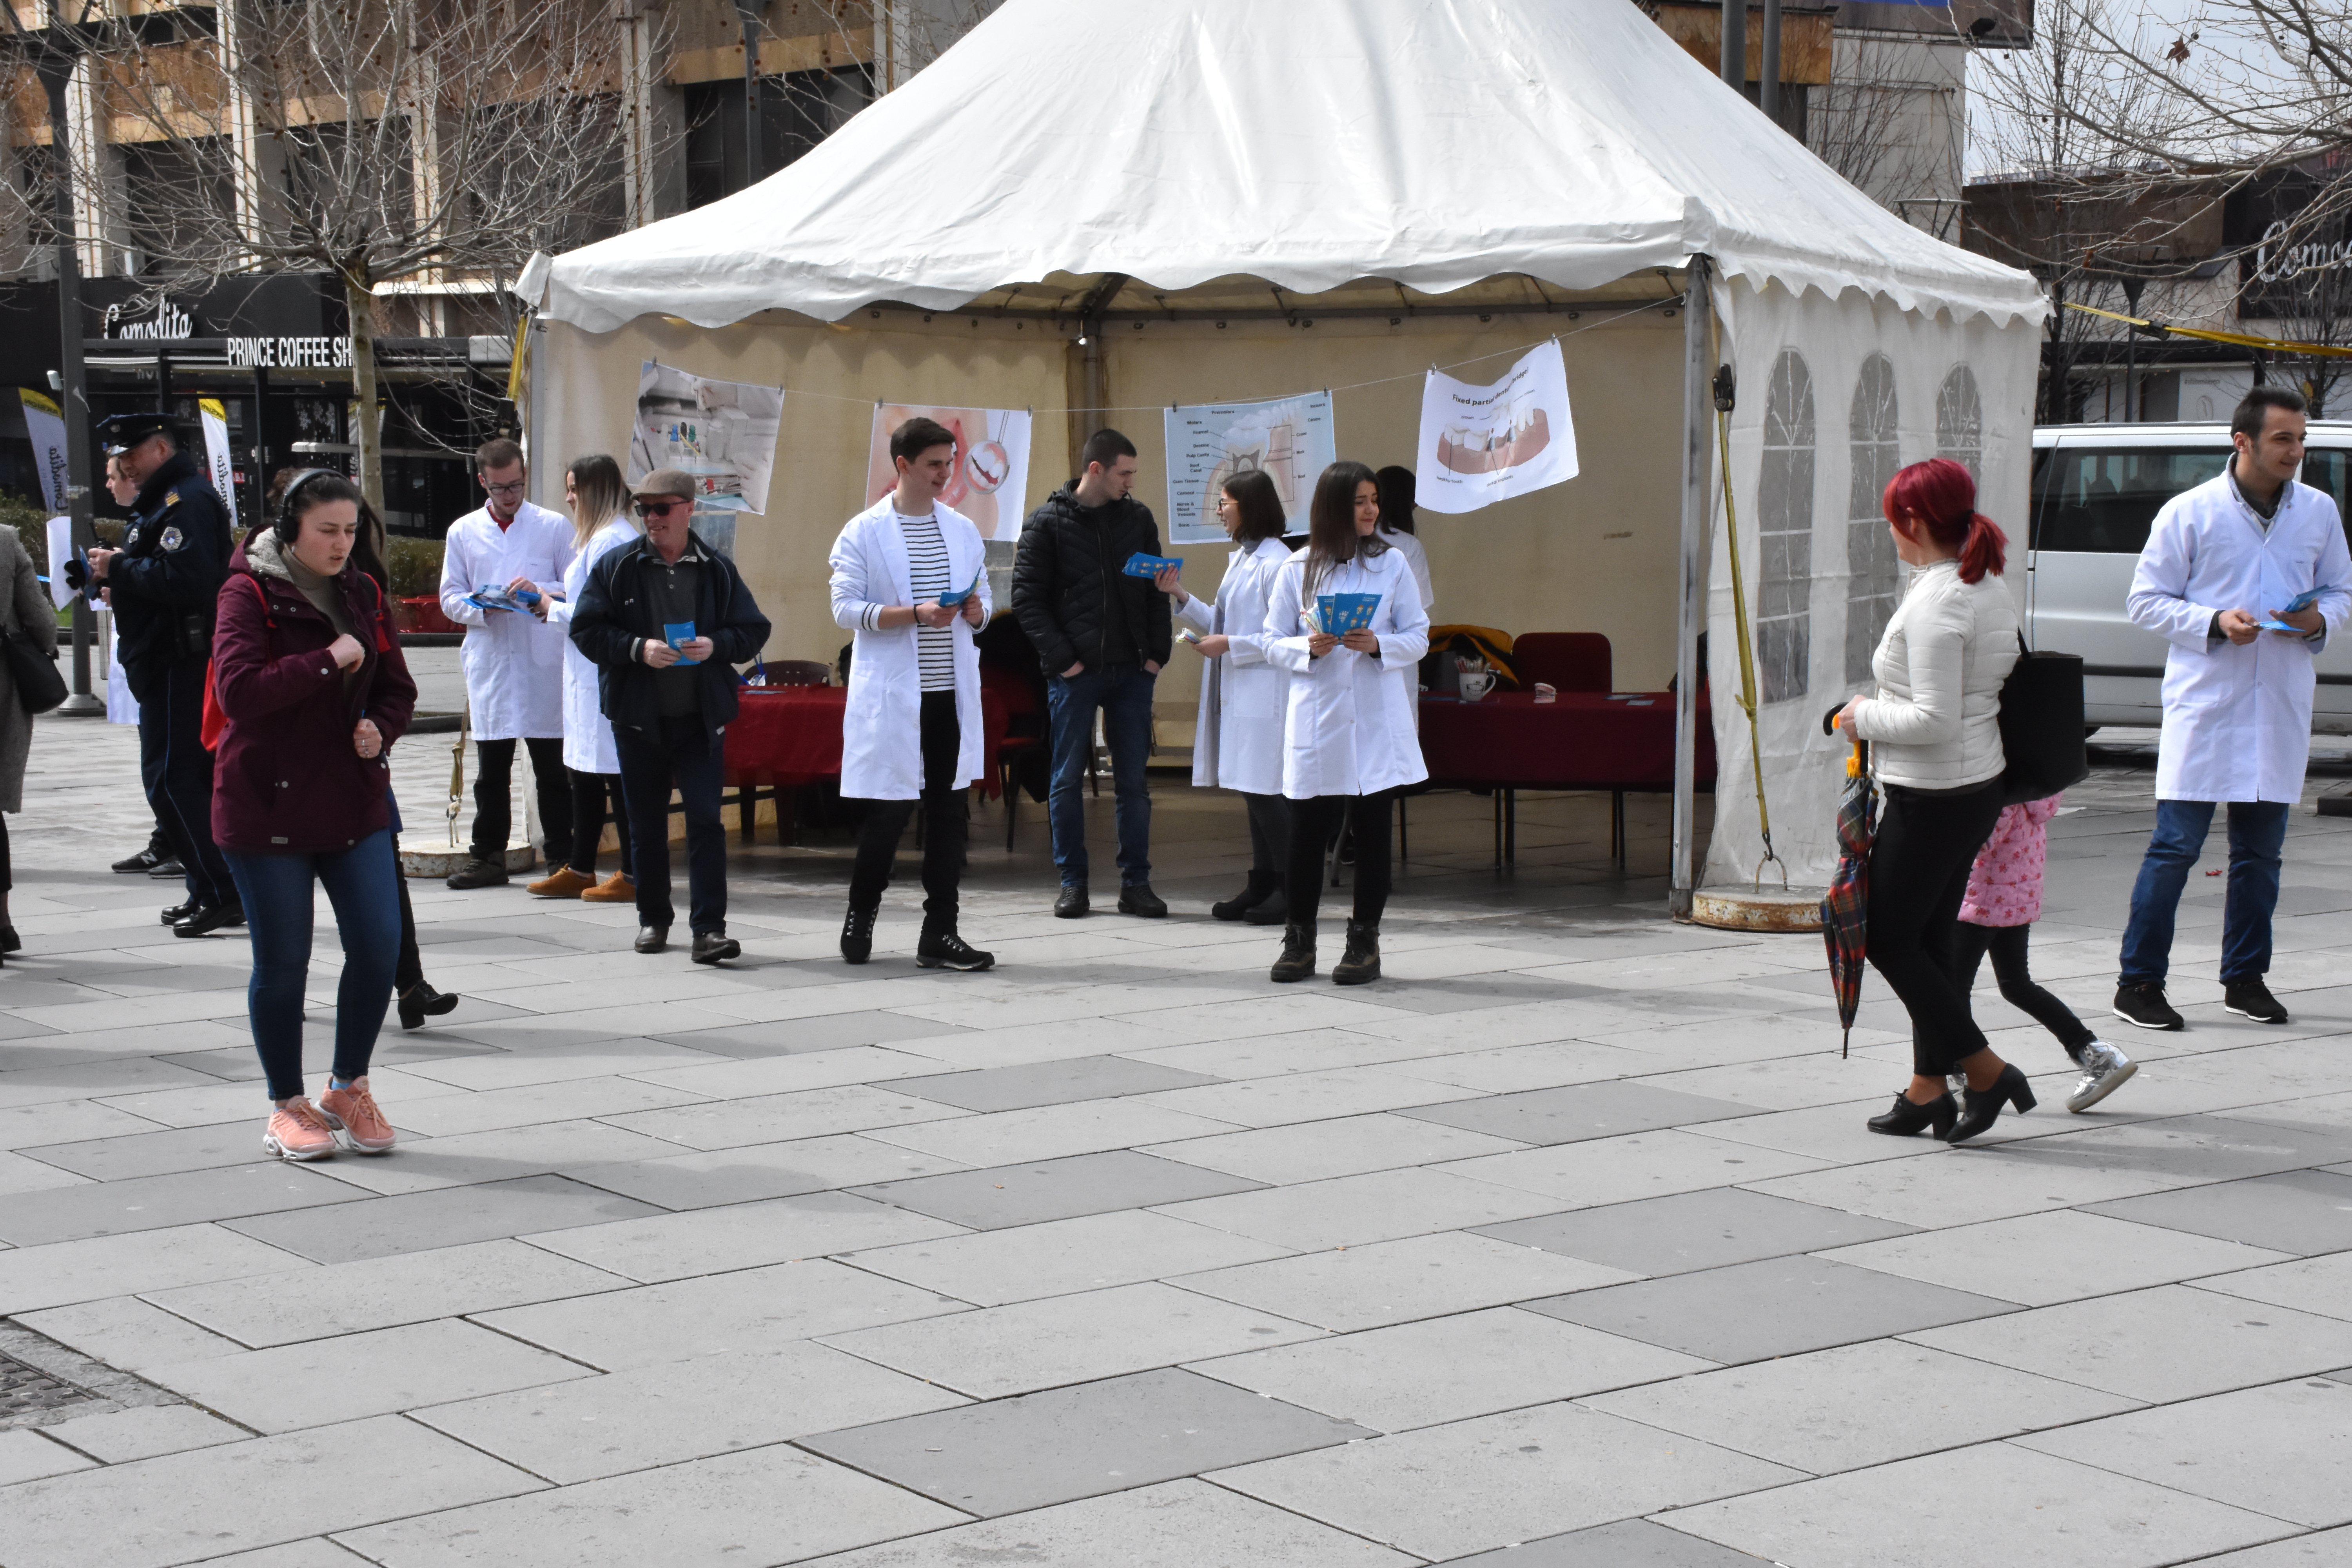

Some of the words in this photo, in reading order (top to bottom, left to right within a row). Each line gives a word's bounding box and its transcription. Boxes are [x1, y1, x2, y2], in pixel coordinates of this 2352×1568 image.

[2257, 220, 2352, 283] Como
[227, 338, 275, 367] PRINCE
[278, 337, 330, 367] COFFEE
[333, 337, 352, 367] SH
[1452, 394, 1470, 404] Fixed
[1472, 396, 1495, 407] partial
